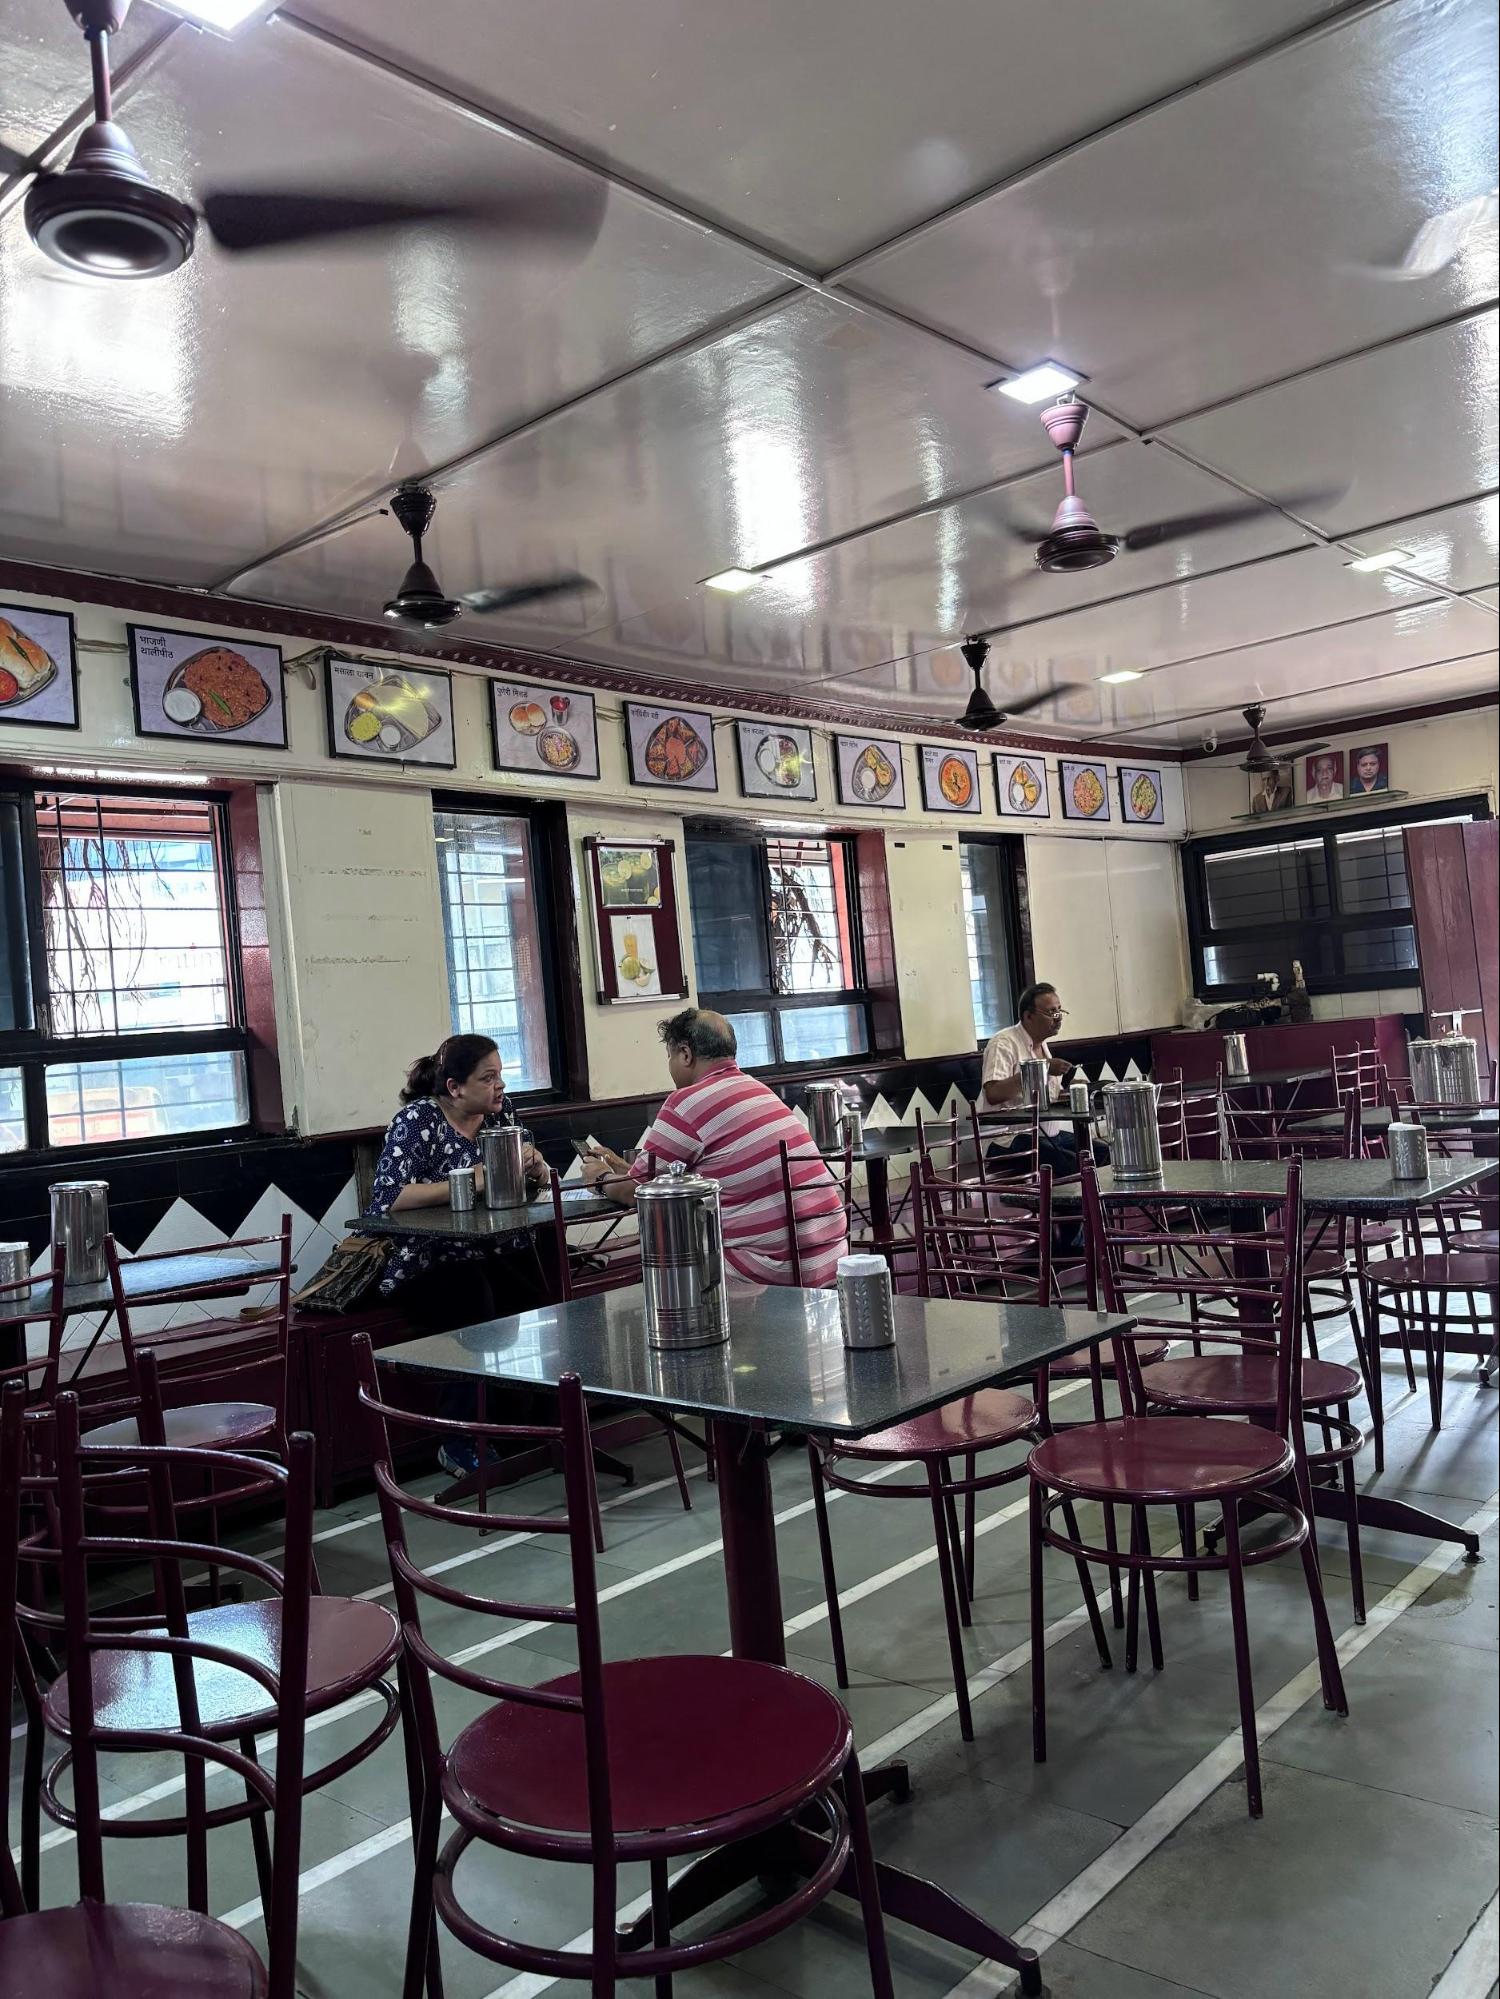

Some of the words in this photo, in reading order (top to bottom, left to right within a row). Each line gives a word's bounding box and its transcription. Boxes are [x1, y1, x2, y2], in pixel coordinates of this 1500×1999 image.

[139, 635, 167, 647] भाजणी
[140, 646, 174, 659] थालीपीठ
[334, 666, 356, 677] मसाला
